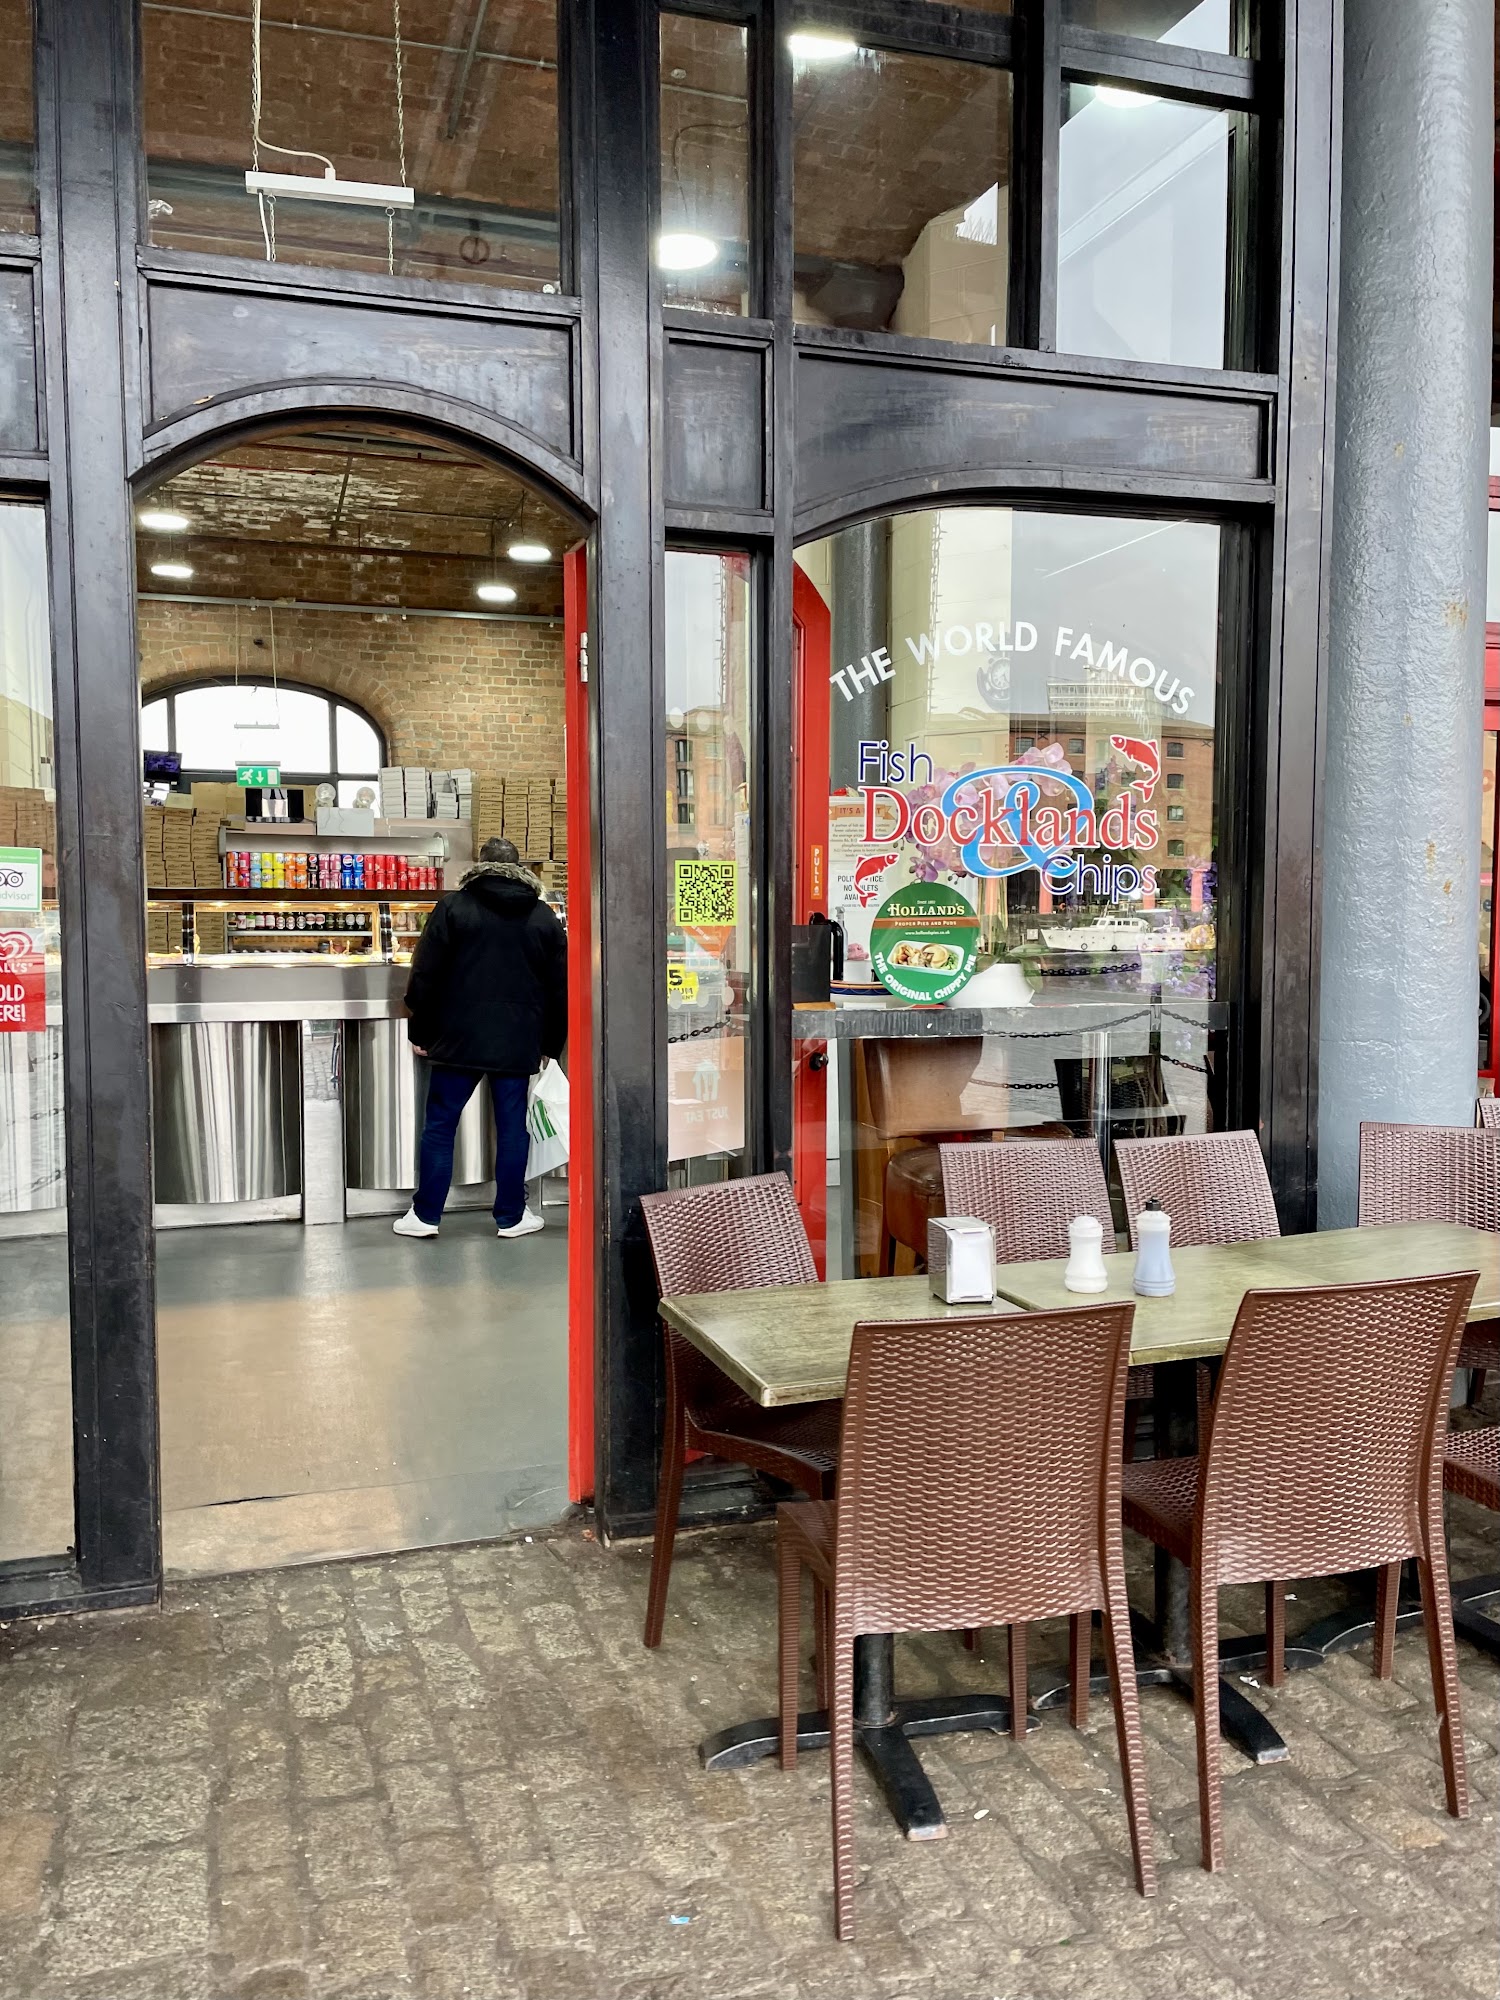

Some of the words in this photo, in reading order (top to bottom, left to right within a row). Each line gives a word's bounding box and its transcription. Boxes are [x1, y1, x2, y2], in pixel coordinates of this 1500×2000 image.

[829, 647, 896, 702] THE
[905, 621, 1038, 665] WORLD
[1054, 626, 1195, 715] FAMOUS
[858, 740, 934, 783] Fish
[858, 786, 1159, 850] Docklands
[1040, 853, 1157, 904] Chips
[887, 903, 965, 916] HOLLAND'S
[875, 952, 888, 974] THE
[885, 974, 932, 1001] ORIGINAL
[934, 972, 967, 999] CHIPPY
[964, 954, 977, 973] PIE
